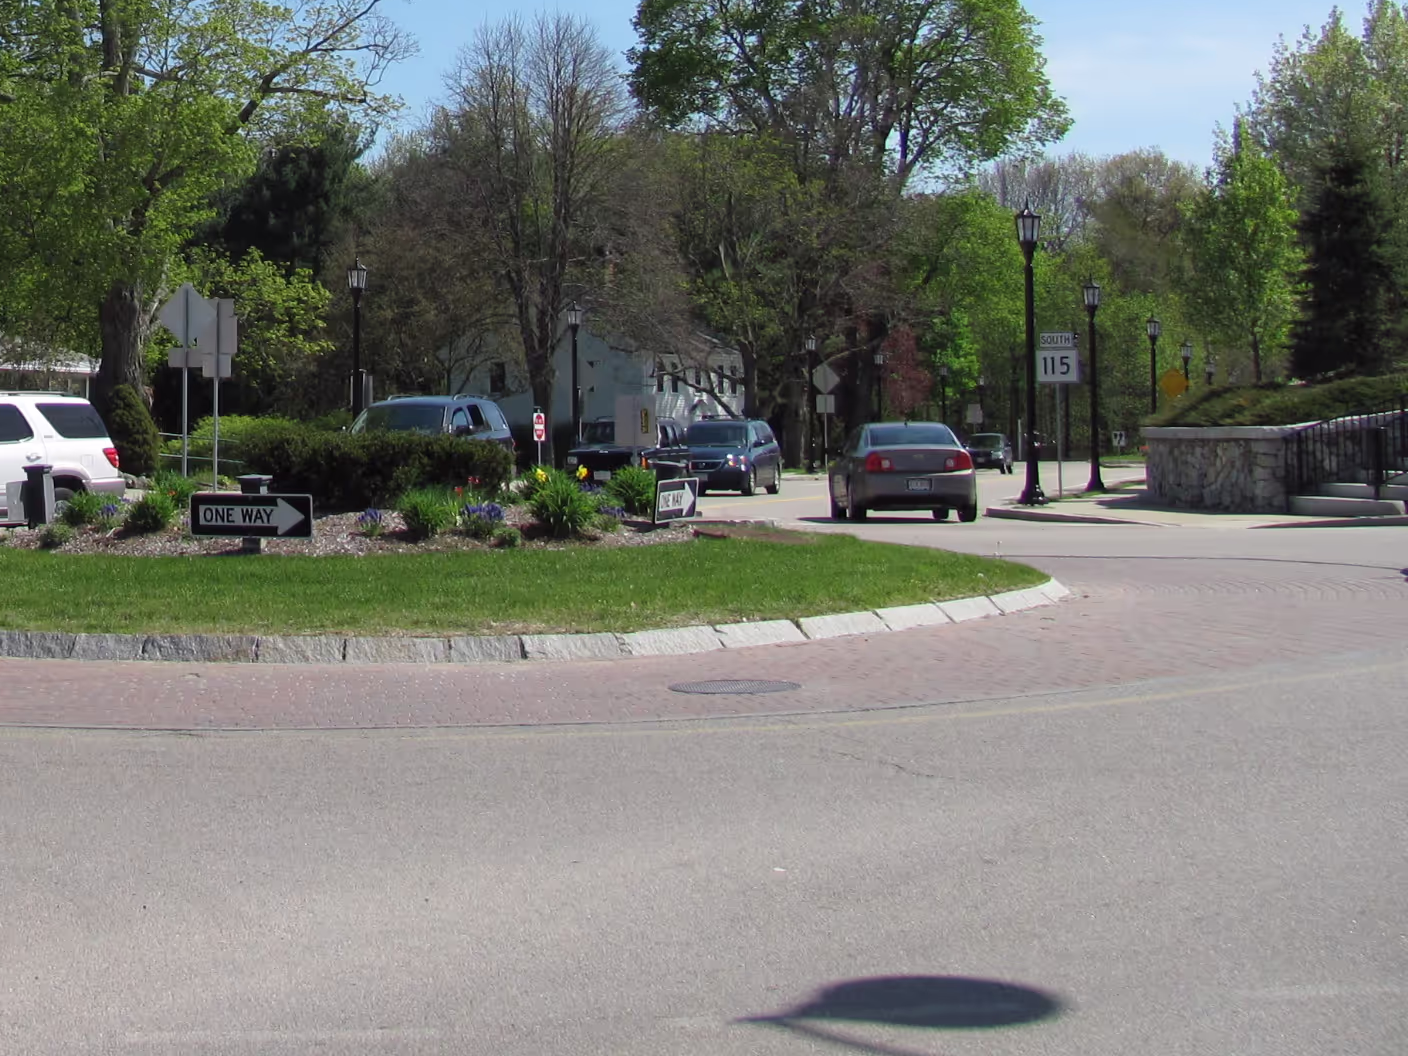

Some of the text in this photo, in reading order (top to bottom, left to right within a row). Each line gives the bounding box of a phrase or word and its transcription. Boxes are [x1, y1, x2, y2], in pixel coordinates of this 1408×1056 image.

[1040, 335, 1071, 345] SOUTH
[1043, 356, 1070, 375] 115
[672, 491, 683, 507] WAY
[203, 507, 273, 524] ONE WAY
